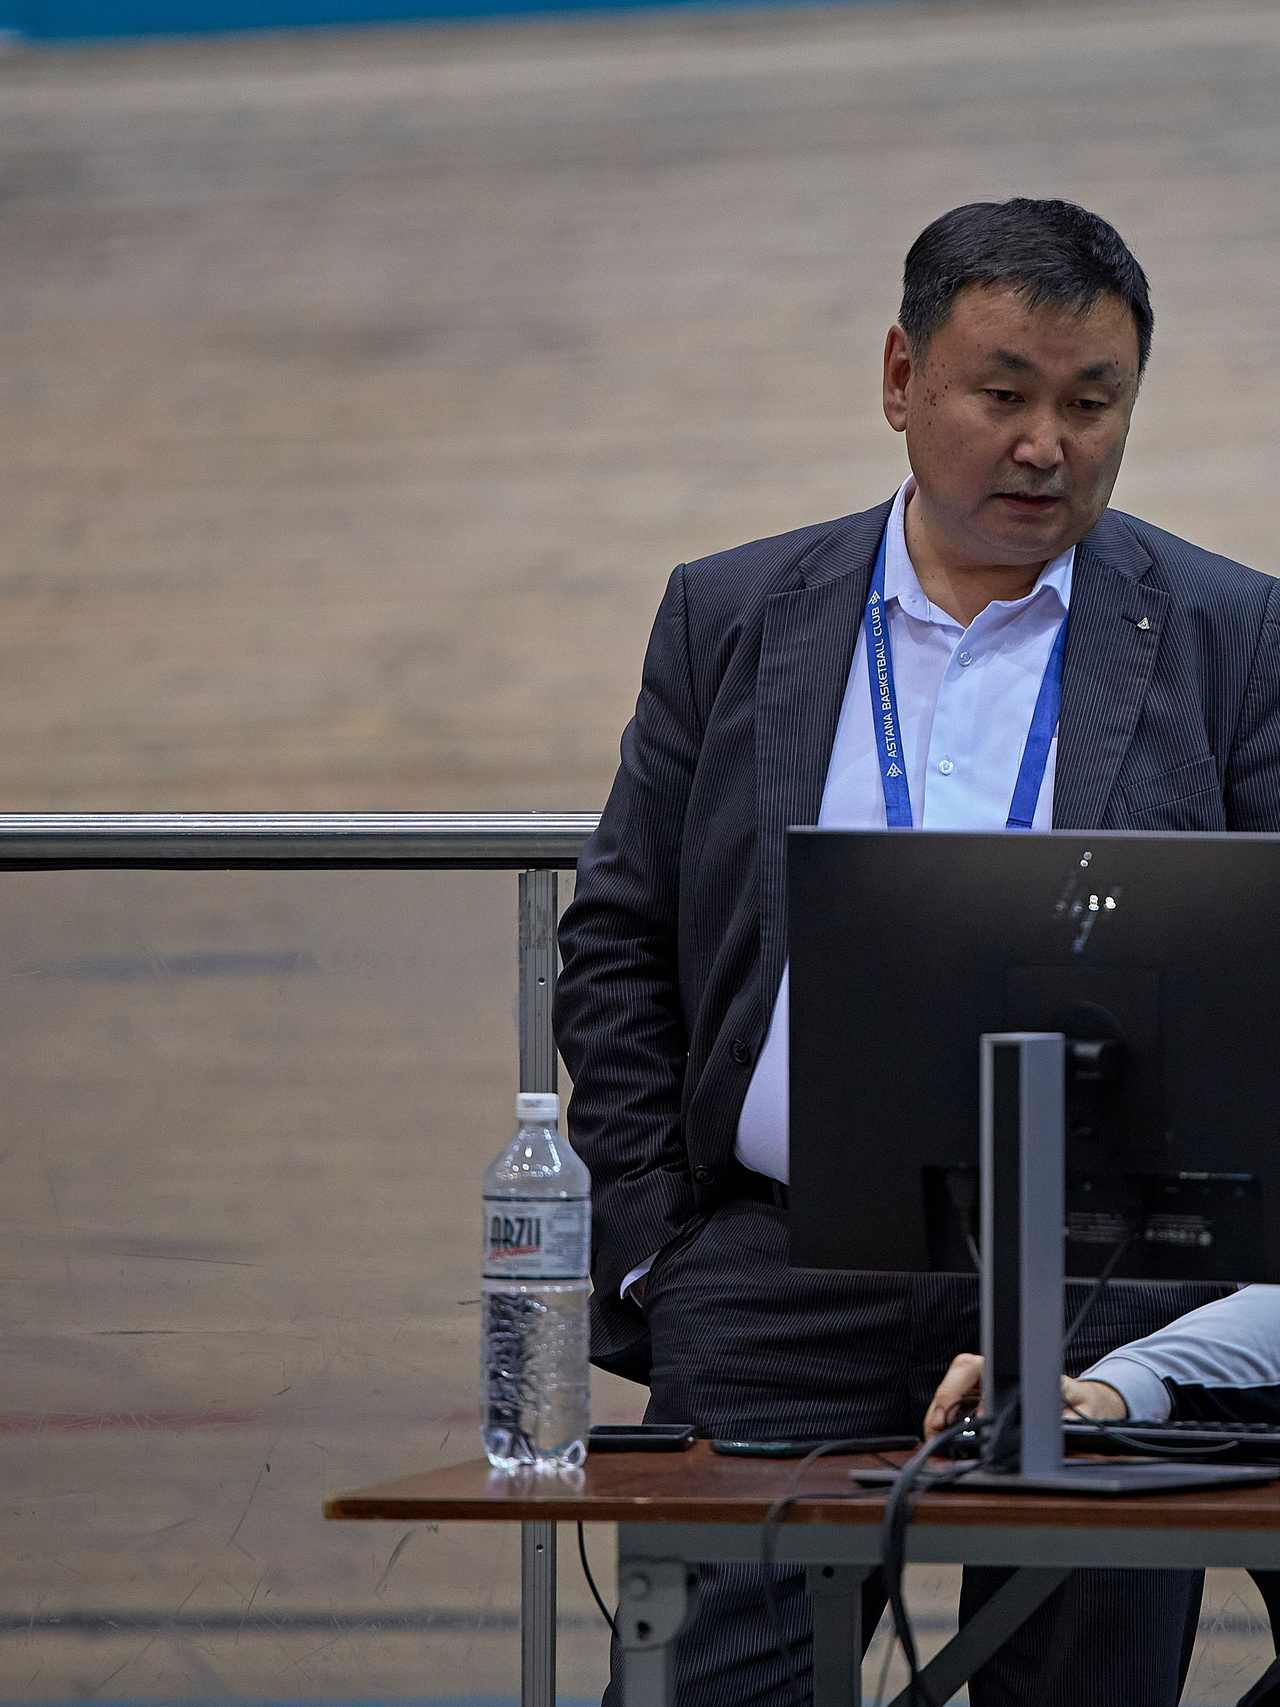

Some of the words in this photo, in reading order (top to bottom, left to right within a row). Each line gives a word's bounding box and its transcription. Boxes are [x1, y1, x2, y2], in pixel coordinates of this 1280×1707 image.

[872, 606, 883, 637] CLUB
[875, 638, 891, 711] BASKETBALL
[883, 712, 898, 758] ASTANA
